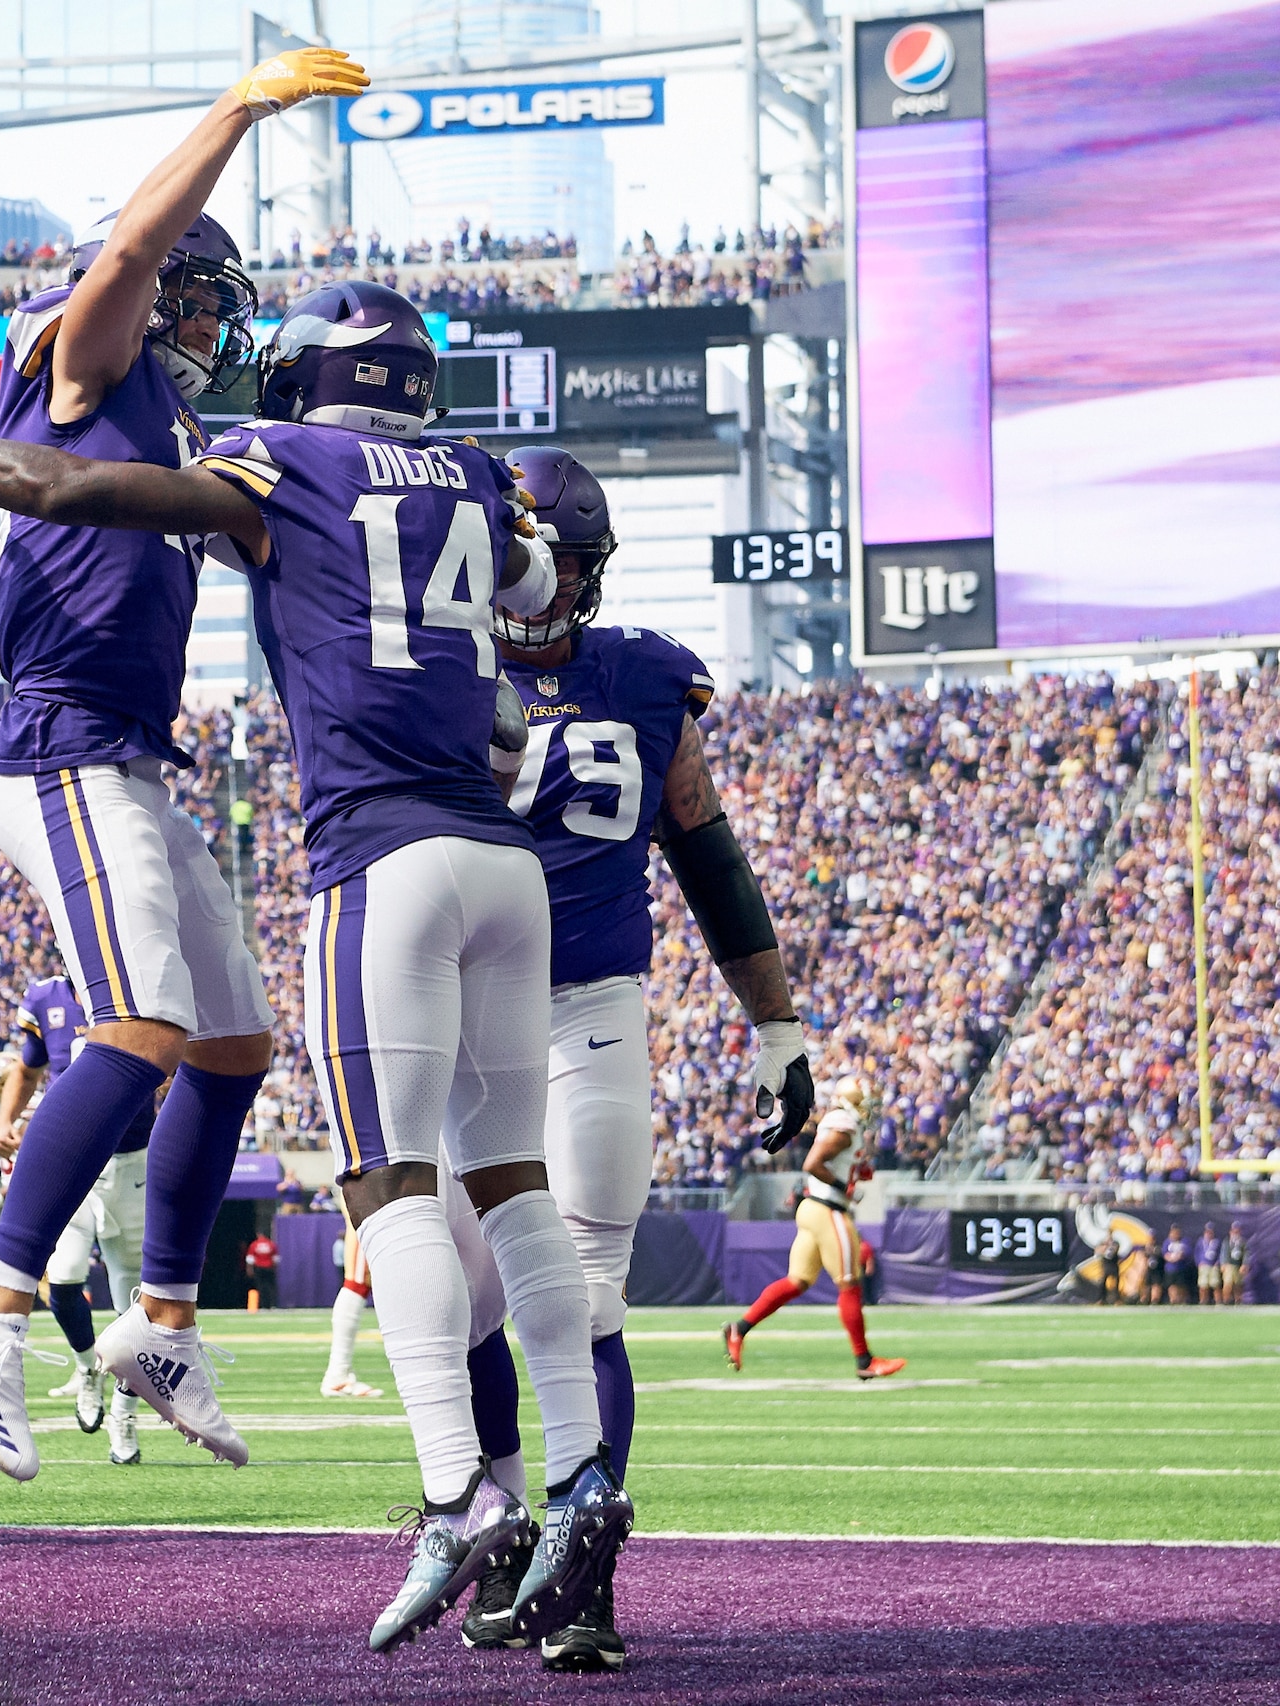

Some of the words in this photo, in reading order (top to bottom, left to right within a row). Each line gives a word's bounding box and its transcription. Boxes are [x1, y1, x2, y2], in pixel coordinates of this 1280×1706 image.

[431, 85, 654, 130] POLARIS
[358, 441, 468, 490] DIGGS
[733, 531, 843, 580] 13:39
[348, 494, 497, 680] 14
[879, 565, 980, 630] Lite
[508, 719, 643, 842] 79
[965, 1217, 1063, 1258] 13:39
